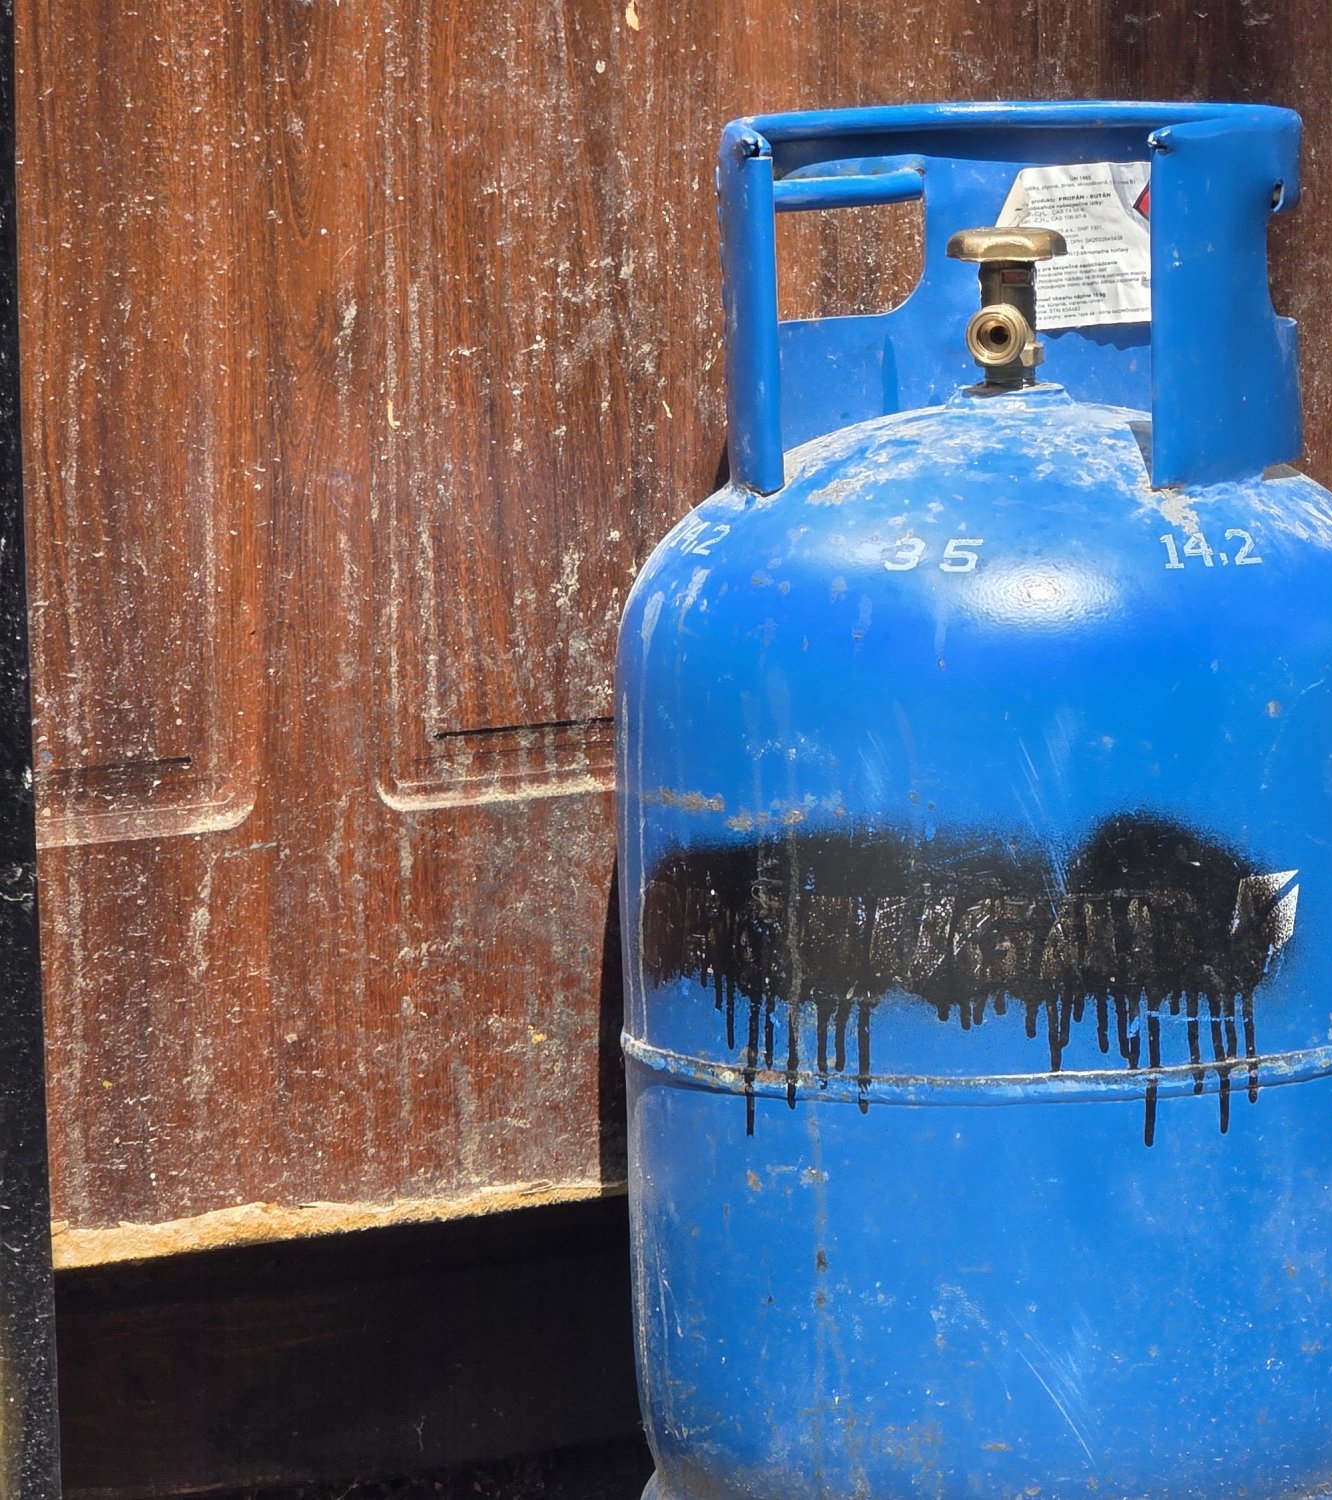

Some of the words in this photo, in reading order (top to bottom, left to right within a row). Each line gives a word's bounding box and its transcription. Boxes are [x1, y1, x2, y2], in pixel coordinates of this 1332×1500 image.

[1058, 194, 1085, 202] PROPÁN
[1089, 191, 1112, 199] BUTÁN
[1160, 528, 1263, 570] 14,2
